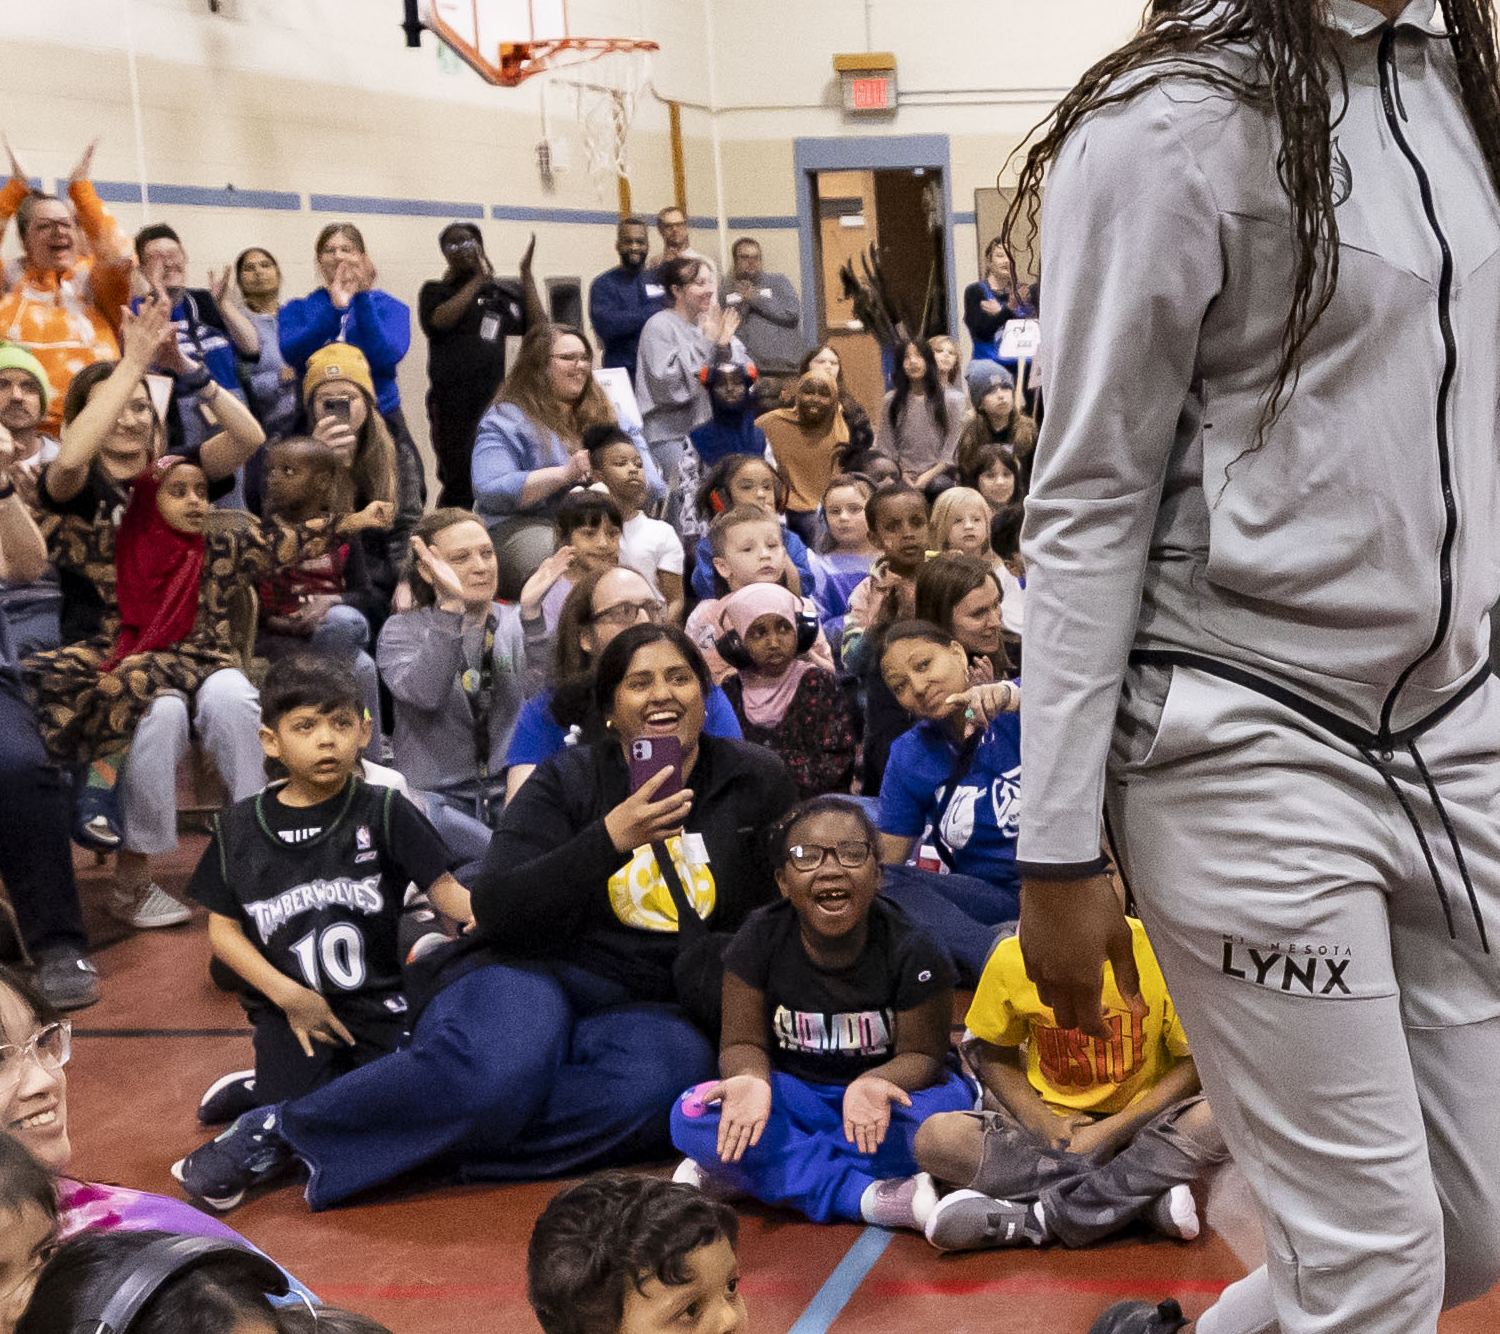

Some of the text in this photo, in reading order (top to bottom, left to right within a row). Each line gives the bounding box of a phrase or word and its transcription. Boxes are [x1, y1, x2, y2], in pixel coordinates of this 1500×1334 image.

[288, 921, 367, 993] 10
[1222, 933, 1352, 956] MINESOTA
[1222, 941, 1352, 995] LYNX
